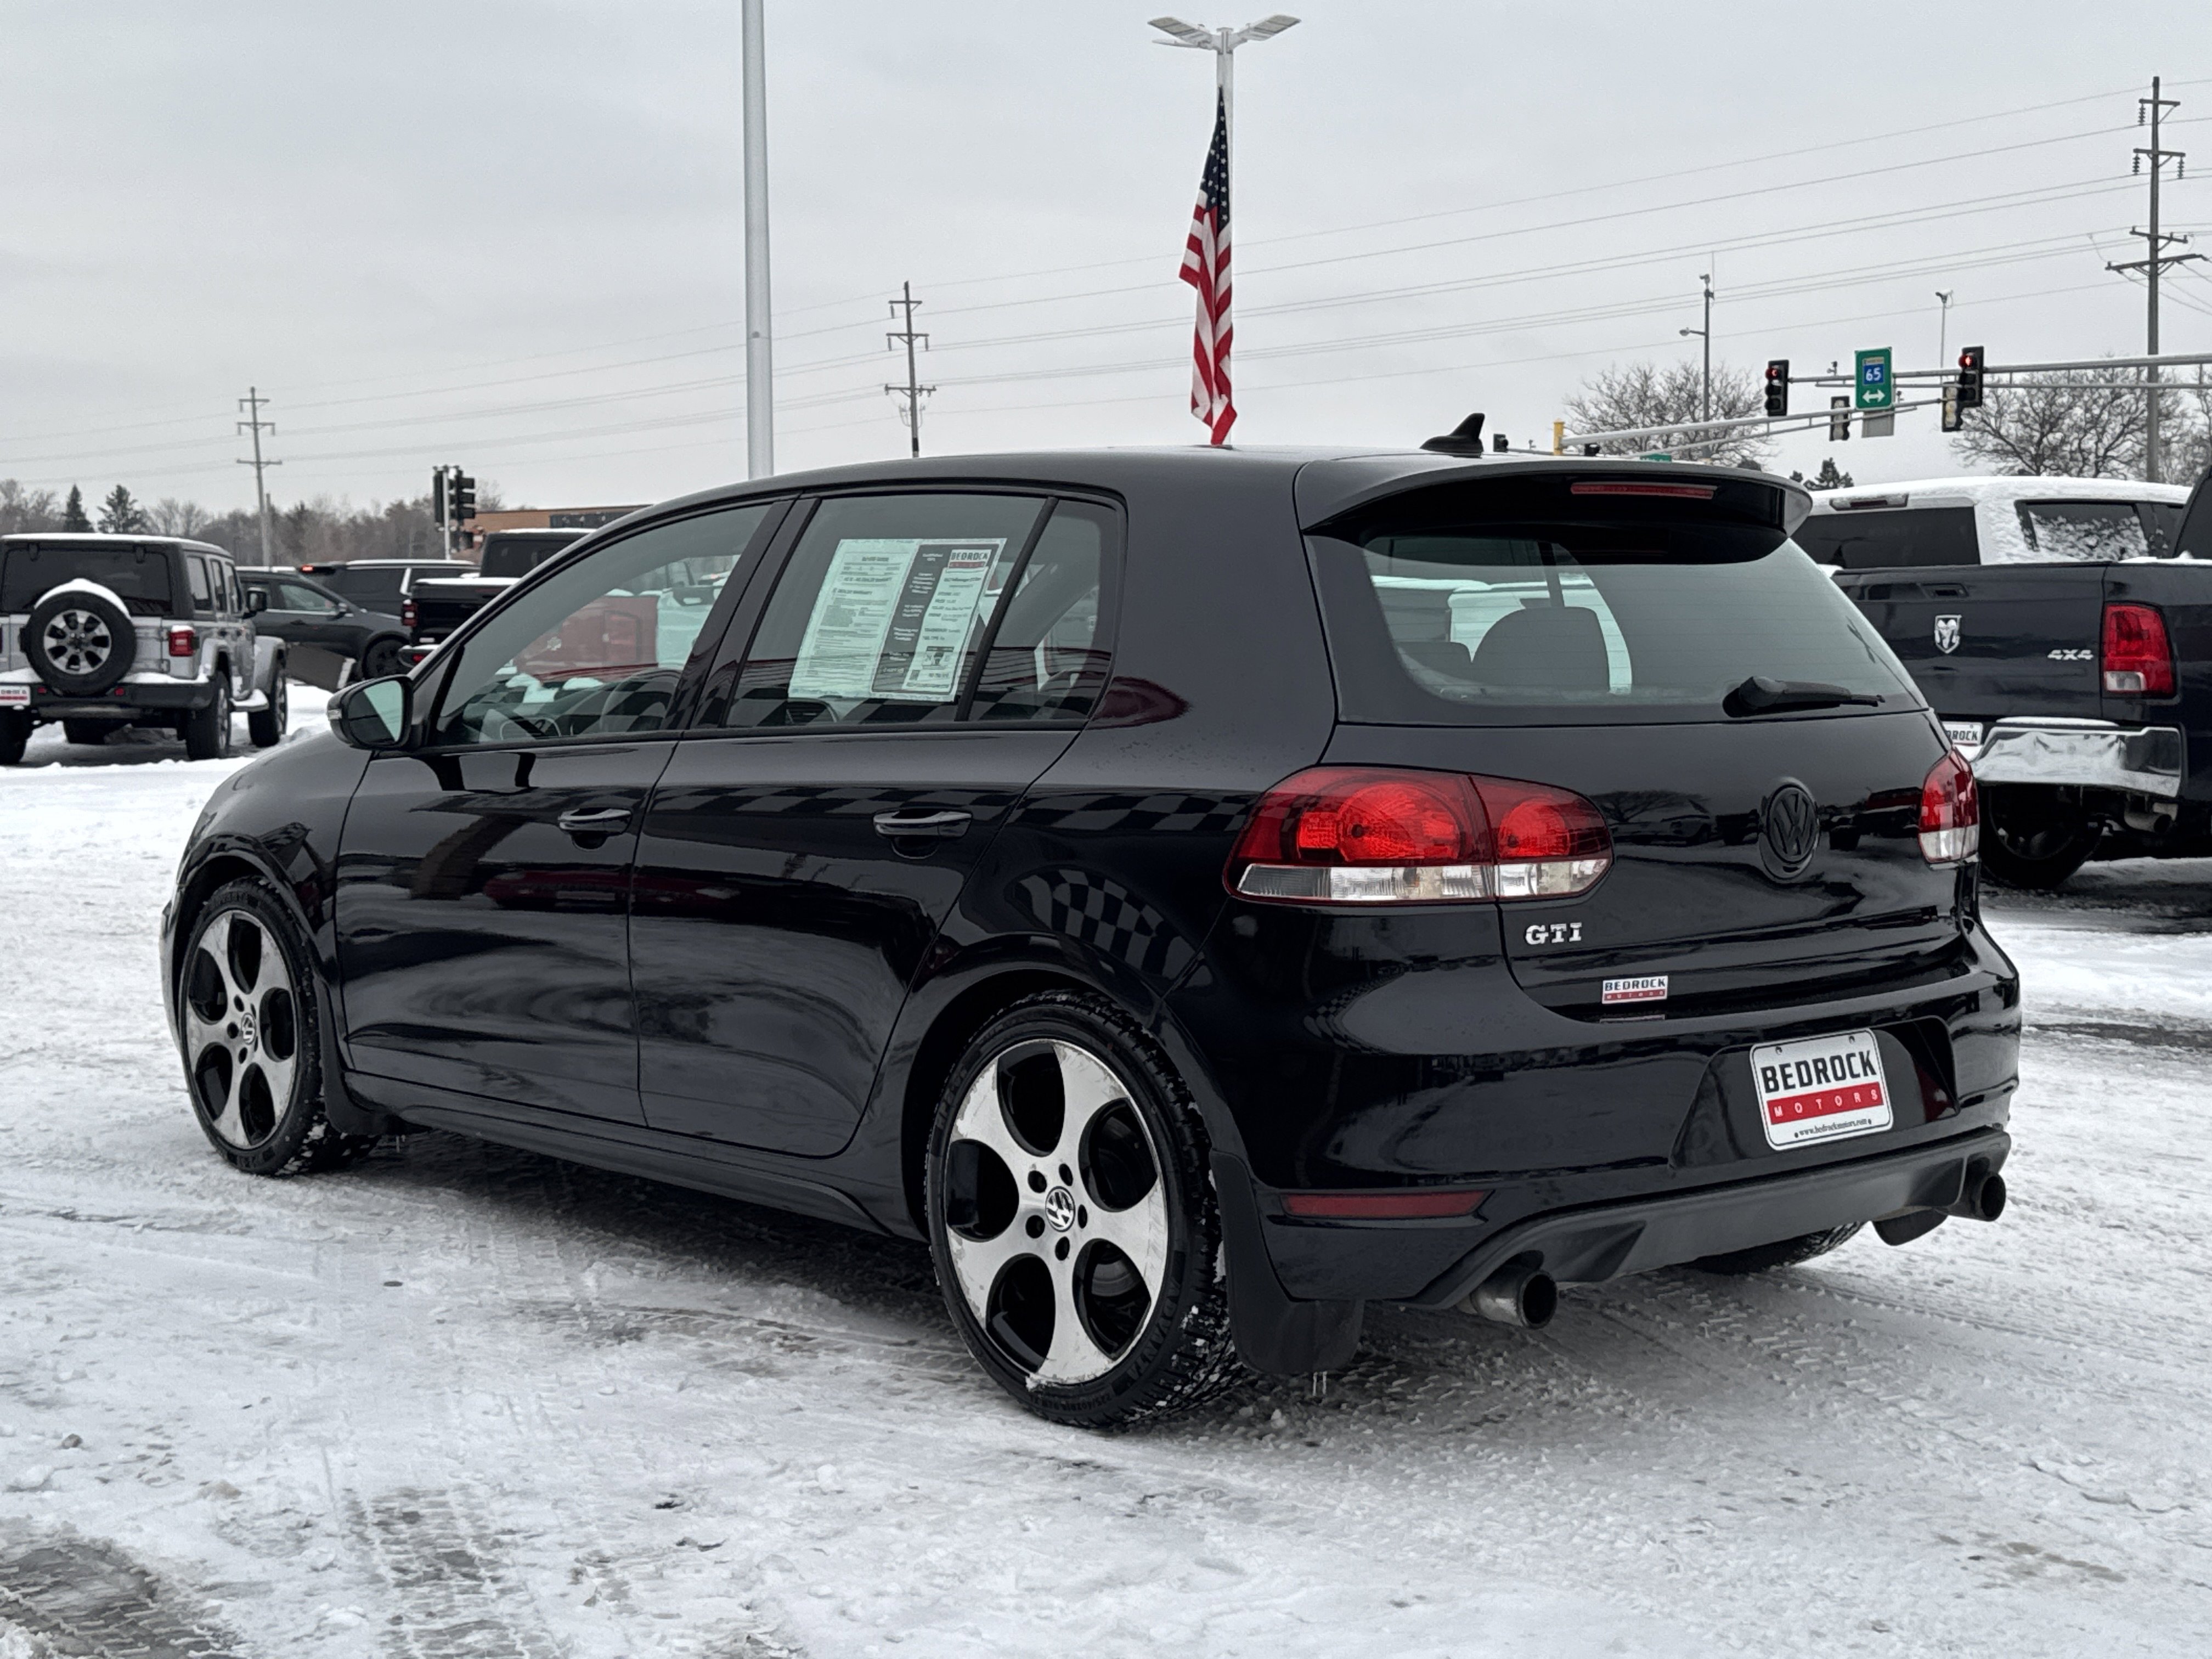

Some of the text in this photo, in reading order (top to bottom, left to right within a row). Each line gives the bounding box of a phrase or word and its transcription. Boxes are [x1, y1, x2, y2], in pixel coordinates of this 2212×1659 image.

[1866, 367, 1881, 381] 65
[1525, 922, 1583, 945] GTI
[1605, 978, 1666, 991] BEDROCK
[1760, 1050, 1877, 1093] BEDROCK
[1774, 1089, 1878, 1117] MOTORS
